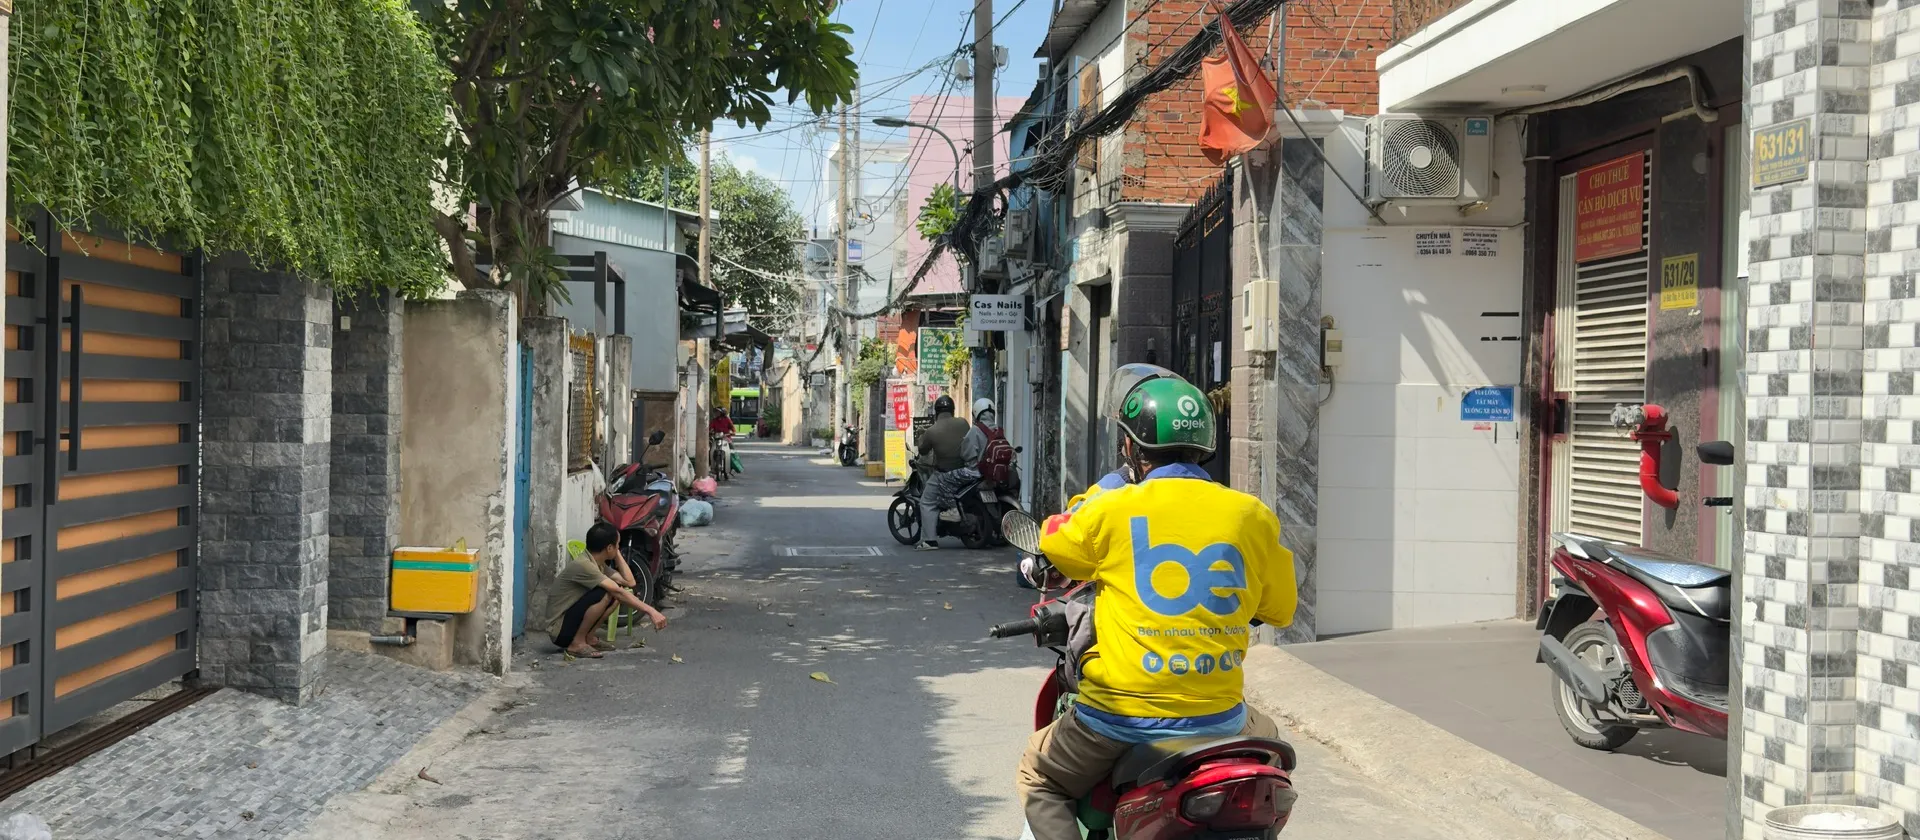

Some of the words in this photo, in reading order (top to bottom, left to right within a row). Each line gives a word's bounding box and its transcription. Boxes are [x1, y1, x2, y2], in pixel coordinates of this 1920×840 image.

[1760, 126, 1804, 161] 631/31
[1590, 172, 1605, 189] CHO
[1607, 187, 1628, 211] DỊCH
[1630, 184, 1642, 206] VỤ
[1664, 260, 1695, 288] 631/29
[974, 301, 992, 309] Cas
[997, 301, 1022, 309] Nails
[1172, 419, 1205, 430] gojek
[1130, 515, 1247, 616] be
[1137, 626, 1161, 637] Bên
[1164, 627, 1196, 637] nhau
[1199, 626, 1221, 637] trọn
